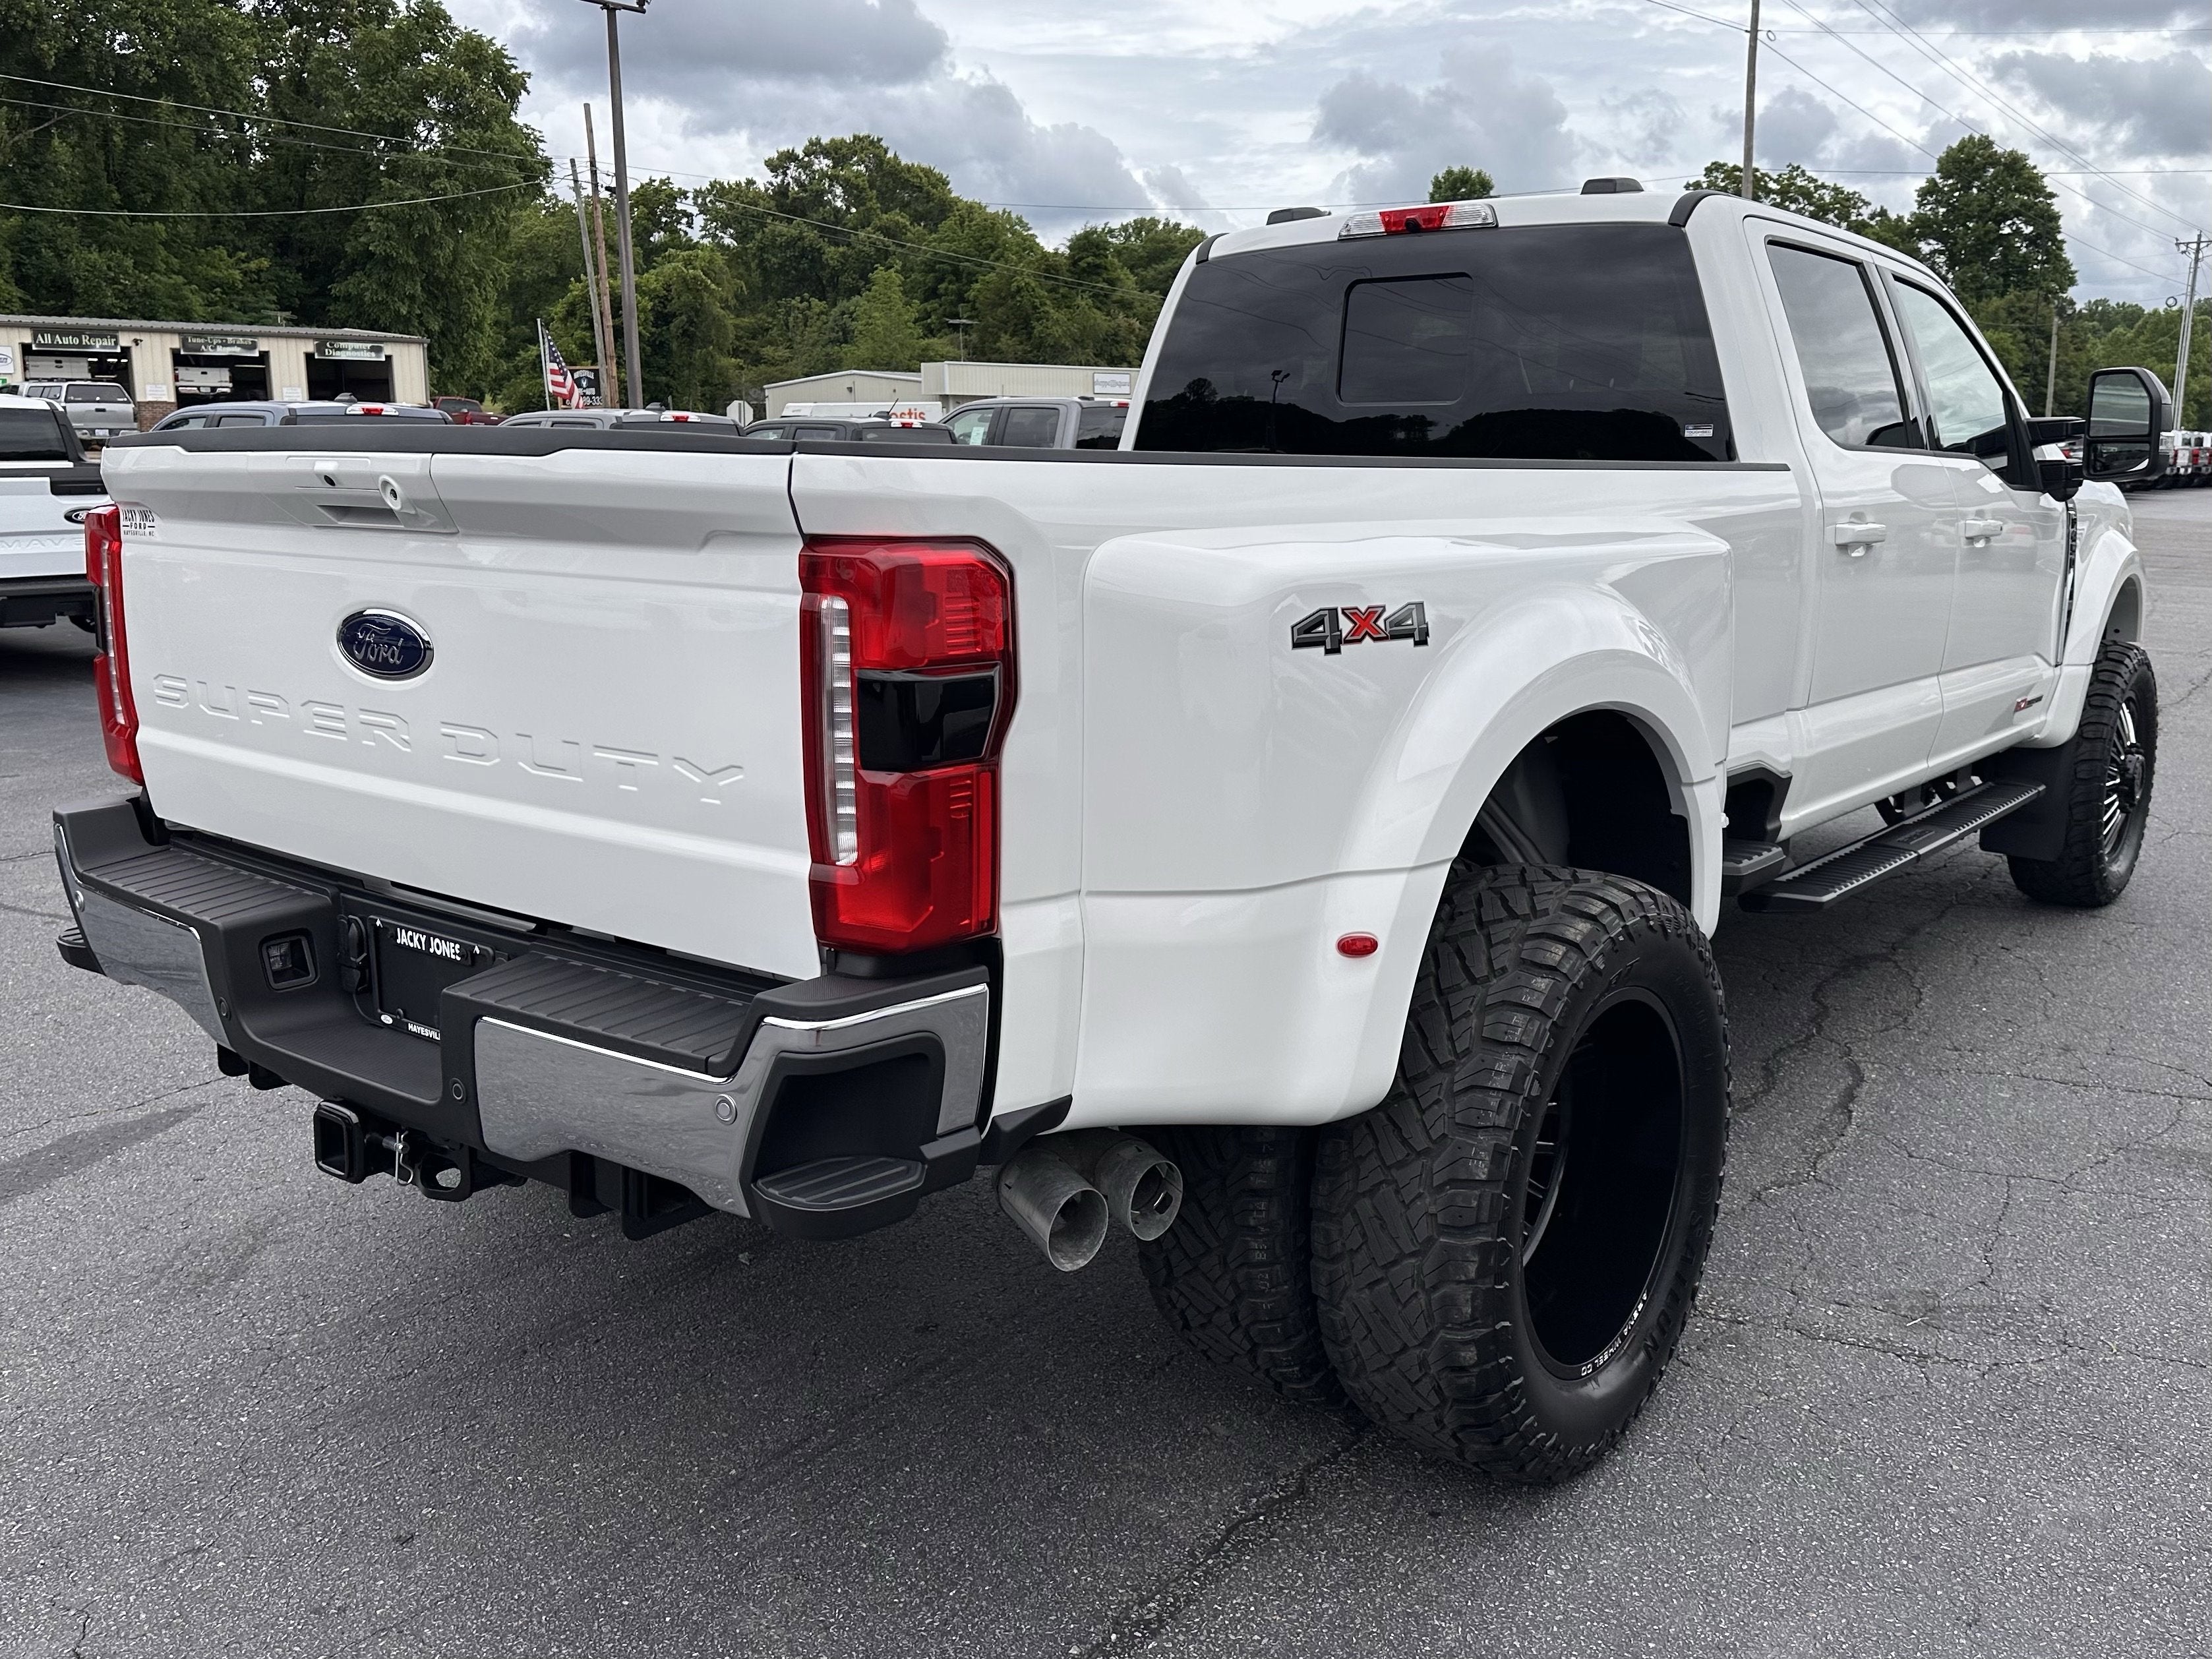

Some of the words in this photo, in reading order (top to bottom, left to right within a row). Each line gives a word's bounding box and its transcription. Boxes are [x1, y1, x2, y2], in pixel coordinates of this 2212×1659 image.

[36, 333, 51, 344] All
[54, 334, 79, 345] Auto
[82, 334, 117, 348] Repair
[326, 341, 371, 349] Computer
[324, 348, 376, 357] Diagnostics
[130, 522, 146, 530] FORD
[353, 622, 405, 665] Ford
[153, 673, 412, 753] SUPER
[439, 720, 745, 806] DUTY
[396, 927, 427, 951] JACKY
[429, 936, 462, 961] JONES
[1594, 1337, 1622, 1368] WHEEL
[1581, 1363, 1593, 1376] CO
